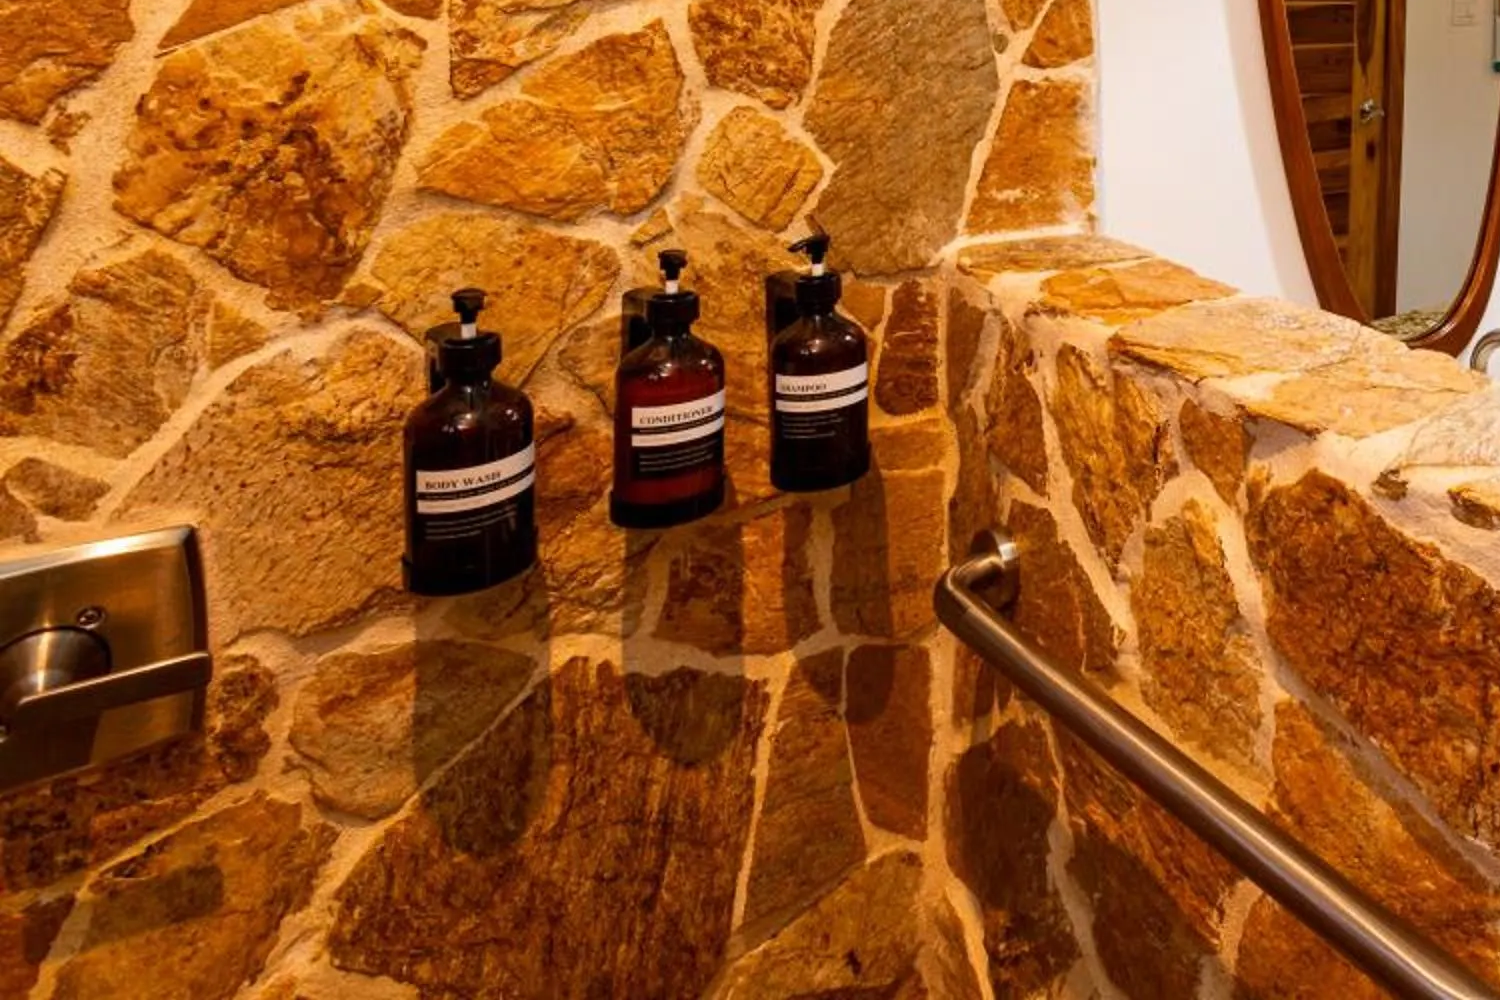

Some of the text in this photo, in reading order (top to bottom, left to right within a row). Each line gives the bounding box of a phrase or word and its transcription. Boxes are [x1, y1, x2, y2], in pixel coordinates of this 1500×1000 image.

[639, 406, 713, 424] CONDITIONER
[425, 479, 459, 490] BODY
[463, 472, 501, 486] WASH
